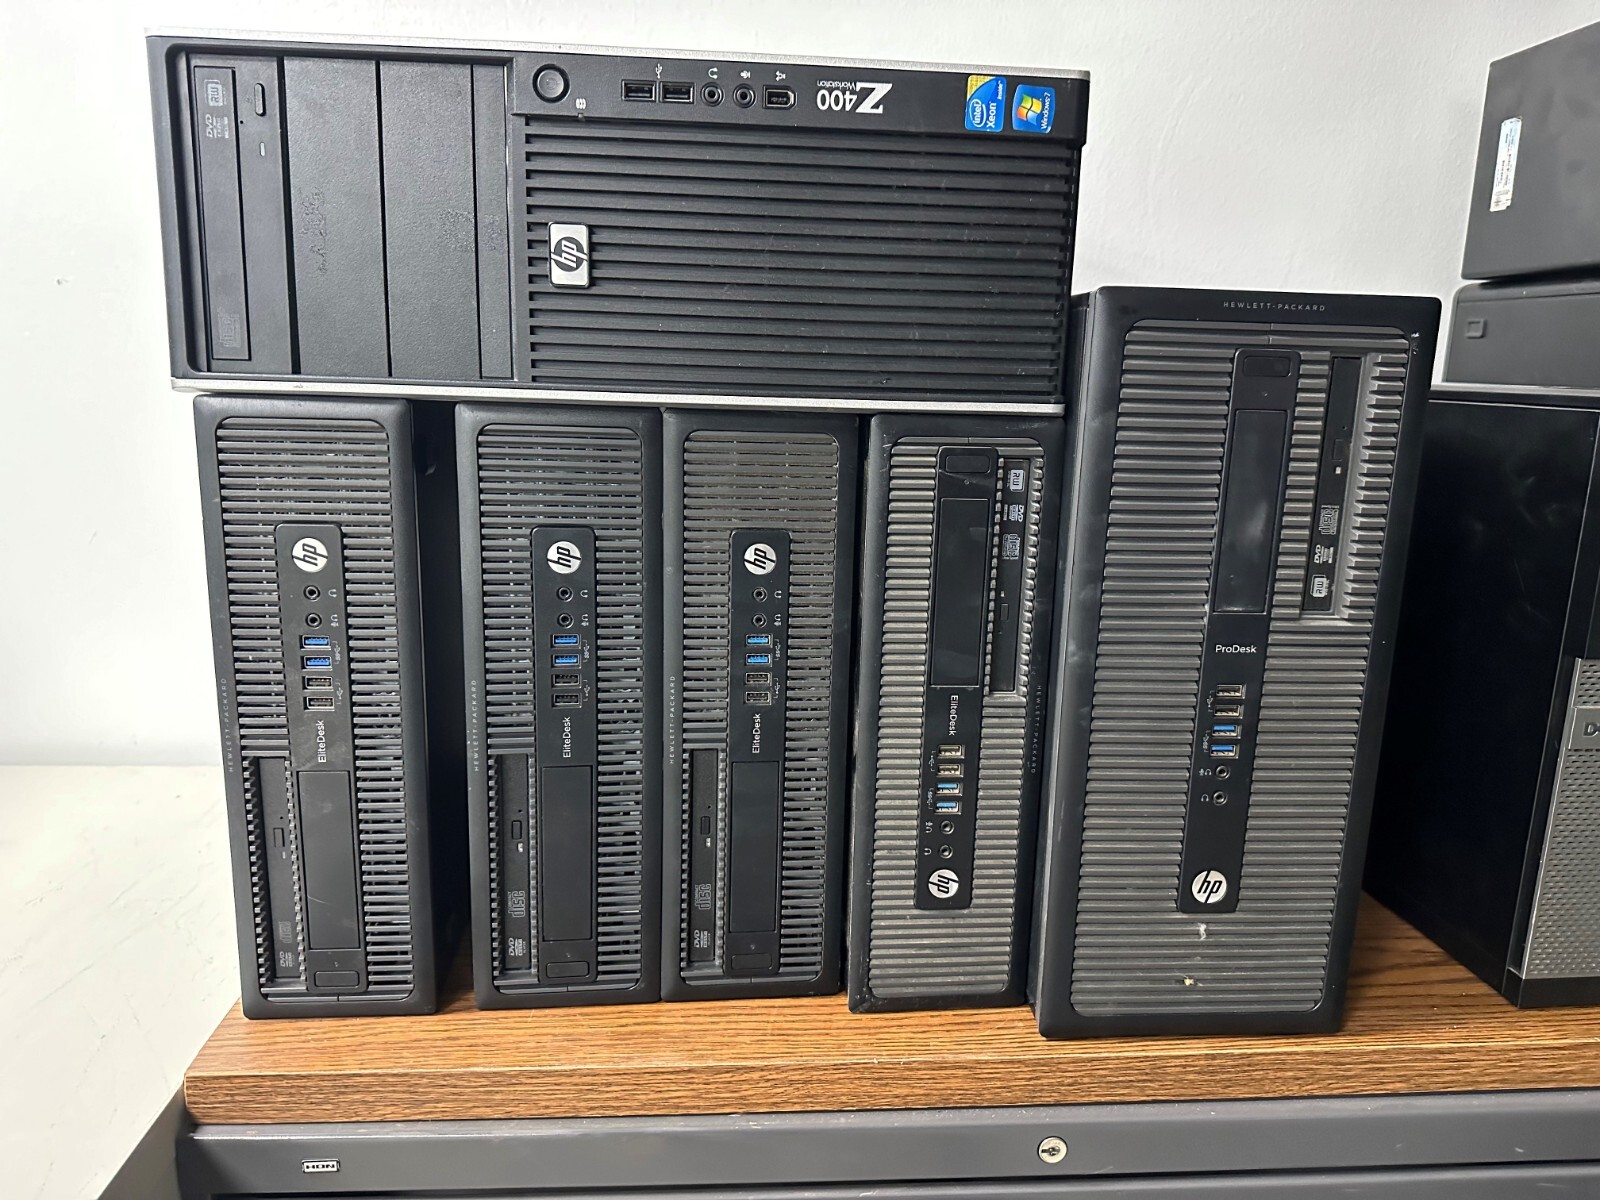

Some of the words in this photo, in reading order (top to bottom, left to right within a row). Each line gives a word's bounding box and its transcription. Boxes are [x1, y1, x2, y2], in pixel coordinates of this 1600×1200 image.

[816, 80, 856, 91] Workstation
[205, 113, 213, 138] DVD
[973, 101, 982, 124] intel
[986, 102, 997, 128] Xeon
[1041, 97, 1051, 130] Windows
[551, 239, 588, 269] hp
[1223, 301, 1325, 311] HEWLETT-PACKARD
[292, 541, 328, 568] hp
[547, 544, 581, 570] hp
[744, 546, 776, 571] hp
[1215, 644, 1257, 654] ProDesk
[220, 678, 234, 773] HEWLETT-PACKARD
[471, 680, 479, 772] HEWLETT-PACKARD
[948, 694, 959, 736] EliteDesk
[317, 719, 327, 763] EliteDesk
[562, 716, 572, 758] EliteDesk
[752, 713, 761, 754] EliteDesk
[1030, 685, 1042, 774] HEWLETT-PACKARD
[928, 872, 959, 896] hp
[1194, 870, 1224, 903] hp
